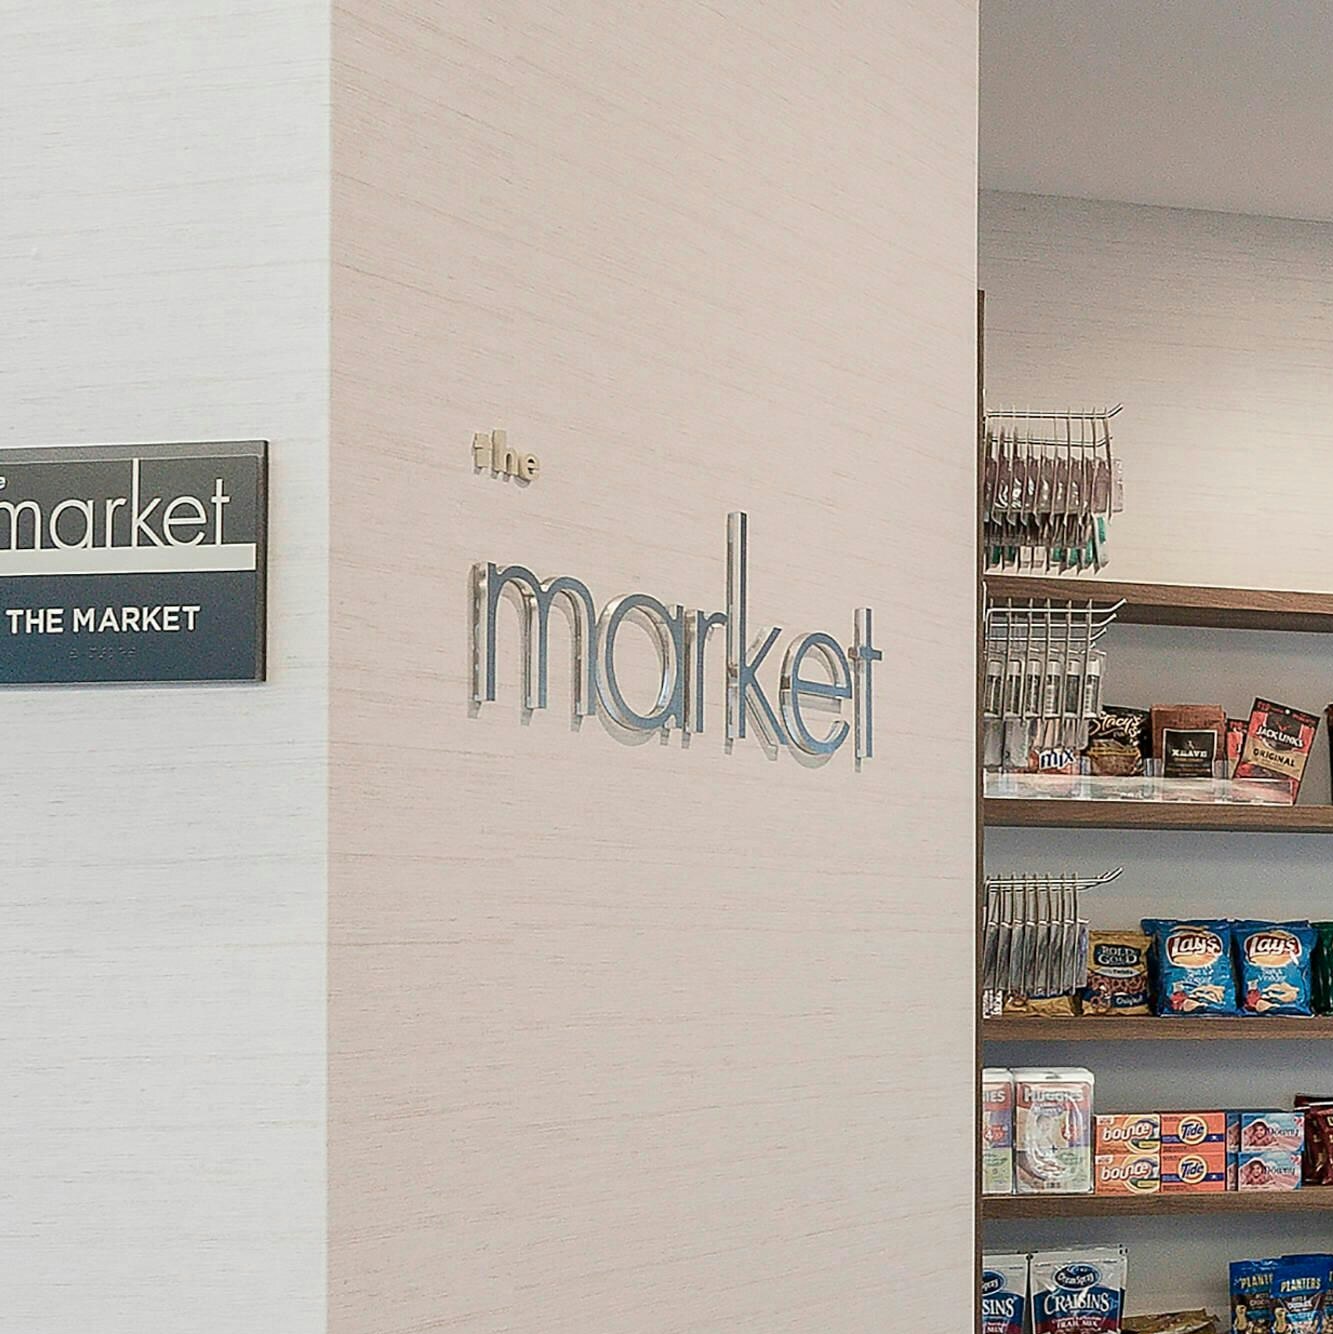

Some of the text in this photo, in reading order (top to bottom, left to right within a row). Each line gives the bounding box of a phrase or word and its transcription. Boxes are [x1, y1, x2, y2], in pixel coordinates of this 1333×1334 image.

[473, 430, 540, 483] the
[6, 606, 200, 633] THE MARKET
[470, 511, 882, 766] market
[1256, 727, 1278, 741] JACK
[1252, 747, 1296, 767] ORIGINAL
[1172, 936, 1220, 957] Lay's
[1252, 935, 1297, 956] Lay's
[1098, 954, 1138, 965] GOLD
[1103, 1120, 1150, 1141] bounce
[1181, 1123, 1204, 1139] Tide
[1101, 1160, 1148, 1181] bounce
[1181, 1161, 1204, 1176] Tide
[1280, 1277, 1321, 1292] PLANTERS
[1044, 1293, 1110, 1314] CRAISINS
